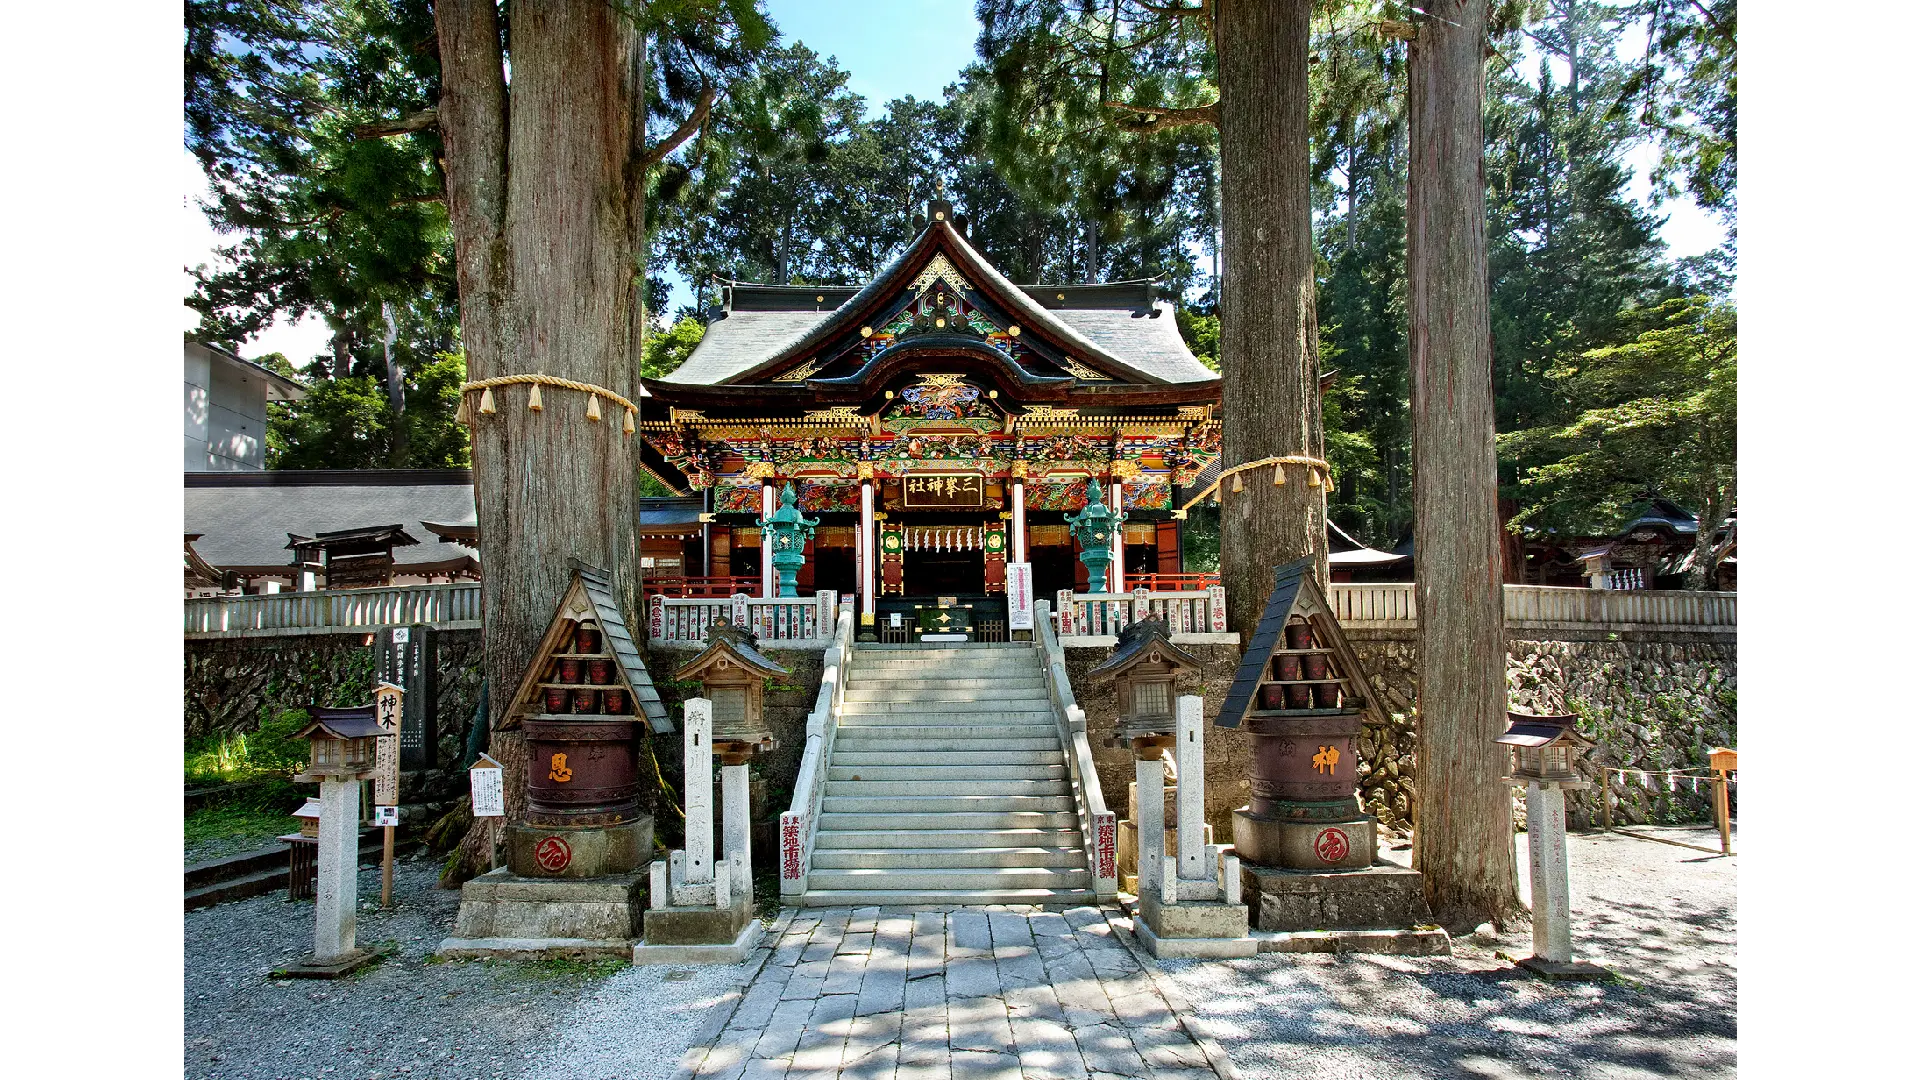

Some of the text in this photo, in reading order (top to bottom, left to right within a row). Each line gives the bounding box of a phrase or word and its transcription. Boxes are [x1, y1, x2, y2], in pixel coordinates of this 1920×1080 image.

[380, 694, 398, 730] 神木
[548, 752, 573, 783] 恩
[1311, 745, 1341, 776] 神
